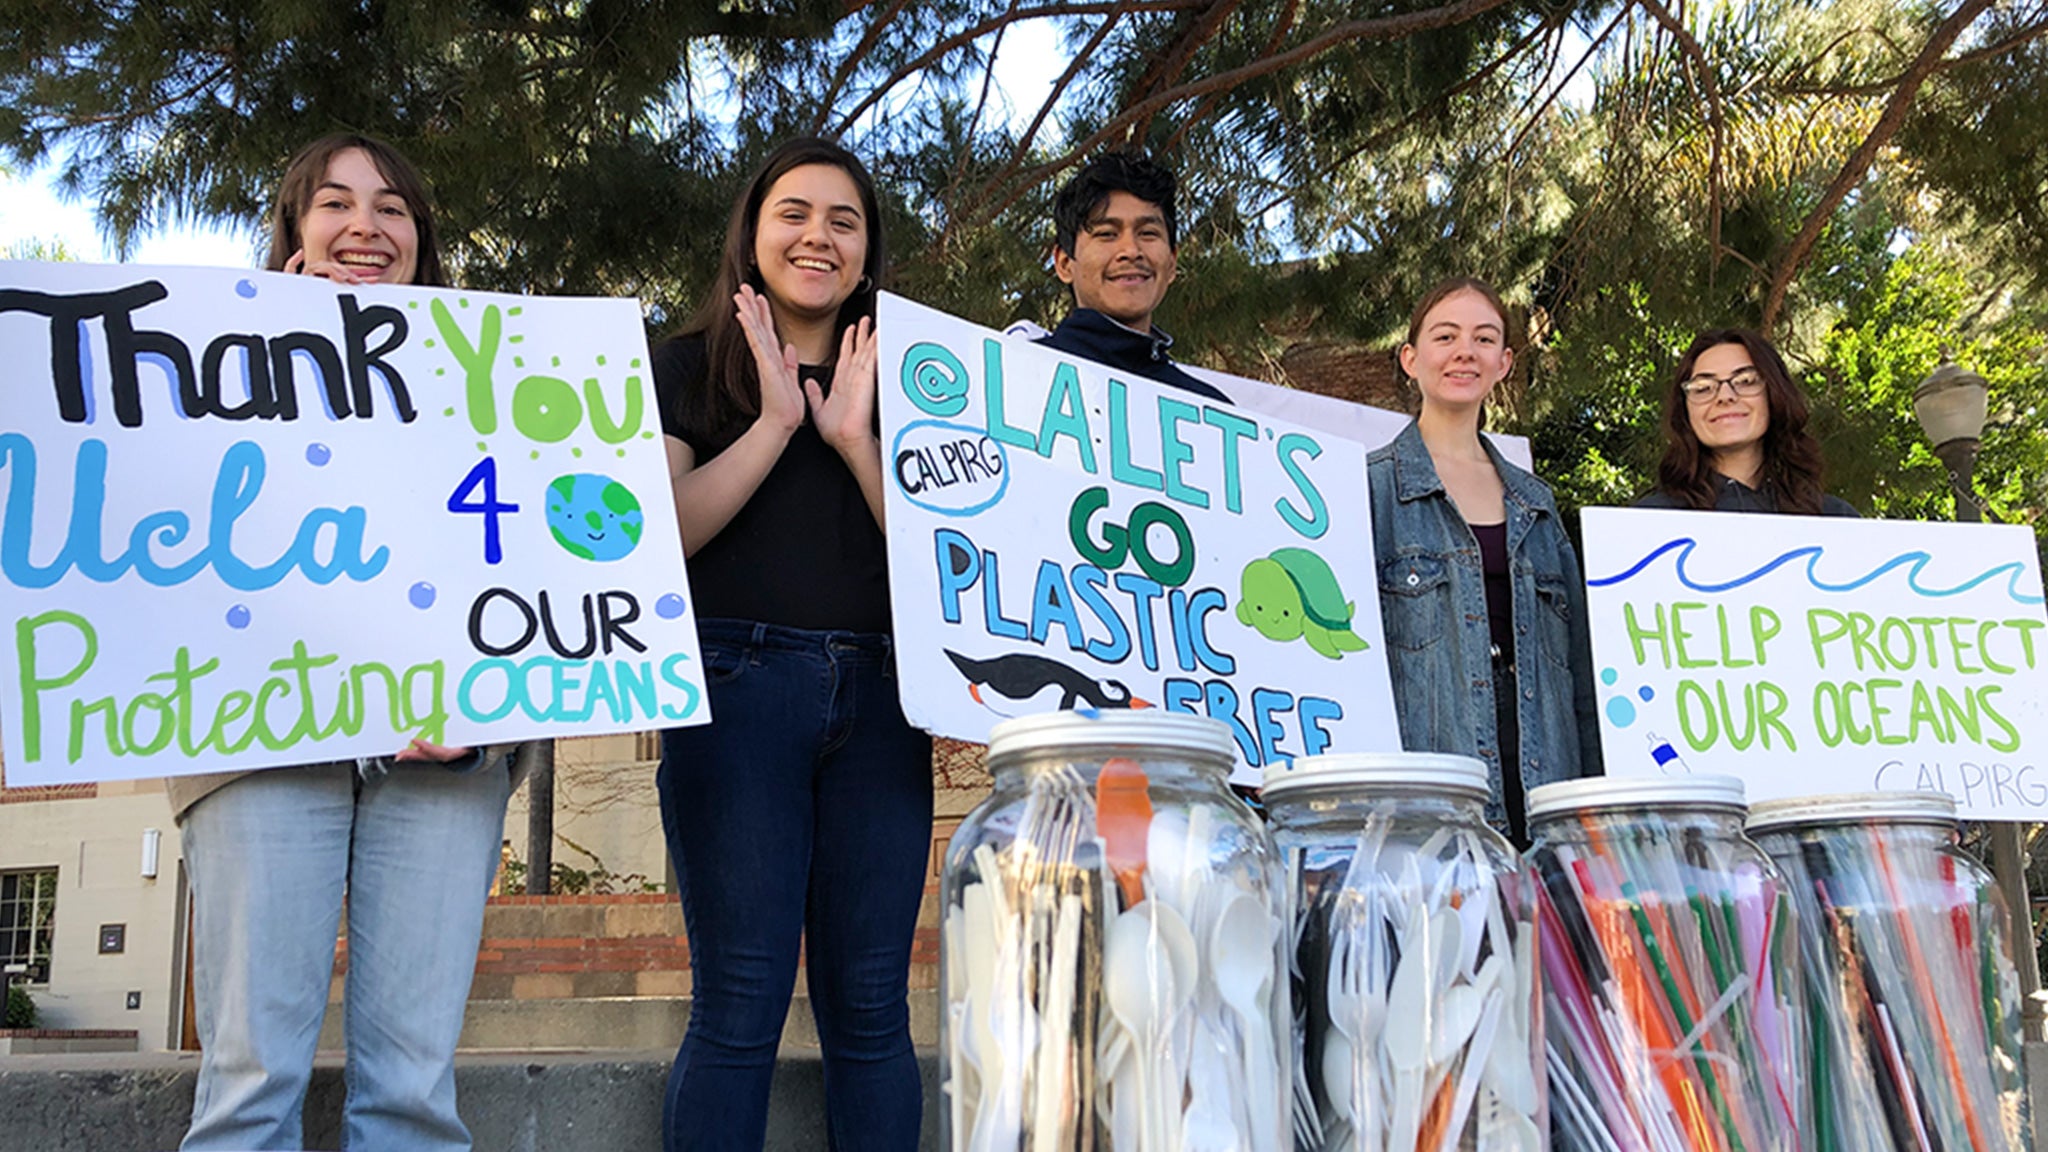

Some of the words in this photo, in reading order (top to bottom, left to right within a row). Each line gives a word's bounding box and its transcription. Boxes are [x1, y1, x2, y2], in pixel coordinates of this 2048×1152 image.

[0, 281, 417, 427] Thank
[429, 297, 643, 443] You
[896, 436, 1003, 495] CALPIRG
[0, 432, 390, 591] Ucla
[447, 456, 520, 564] 4
[1069, 487, 1195, 587] GO
[468, 587, 648, 660] OUR
[934, 528, 1236, 676] PLASTIC
[1624, 602, 1781, 669] HELP
[1807, 608, 2046, 674] PROTECT
[16, 610, 449, 764] Protecting
[458, 652, 700, 723] OCEANS
[1676, 679, 1797, 752] OUR
[1813, 678, 2021, 753] OCEANS
